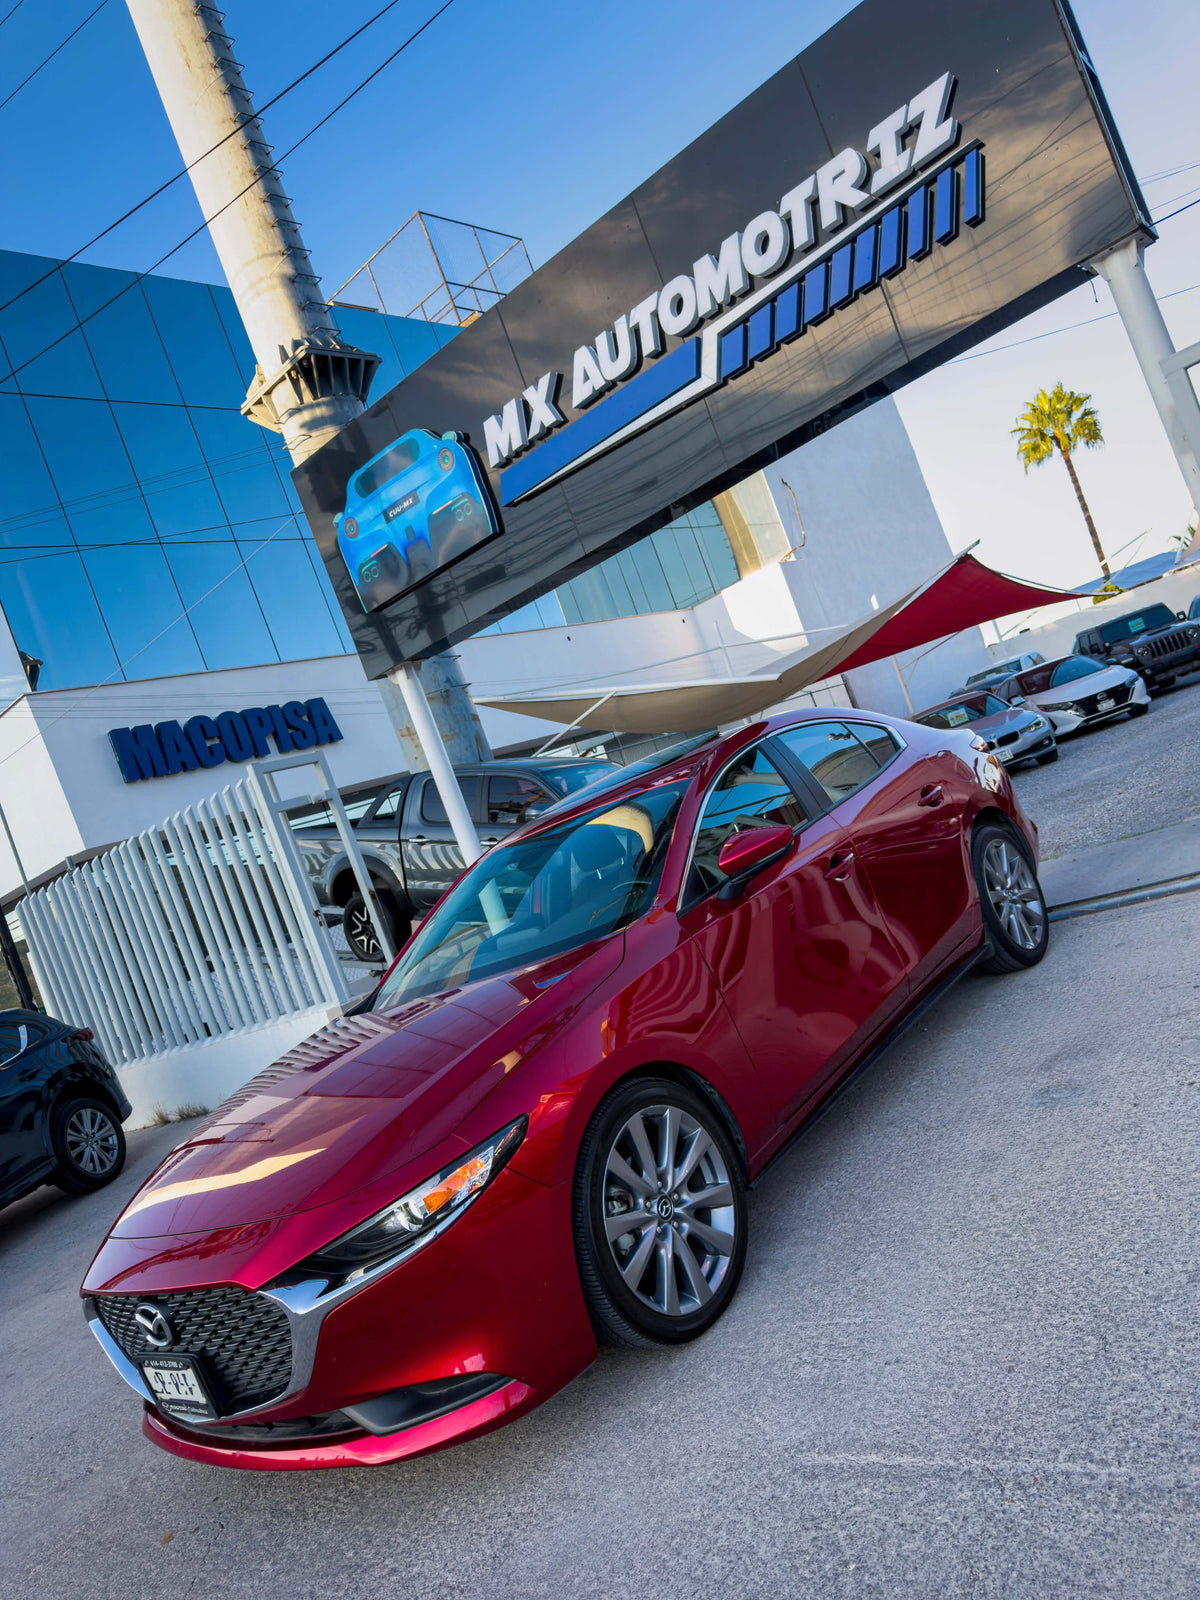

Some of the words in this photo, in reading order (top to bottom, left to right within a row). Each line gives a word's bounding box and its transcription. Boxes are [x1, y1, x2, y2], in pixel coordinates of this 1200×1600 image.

[483, 371, 563, 470] MX
[572, 71, 958, 409] AUTOMOTRIZ
[388, 497, 414, 518] CUU-MX
[107, 697, 344, 784] MACOPISA
